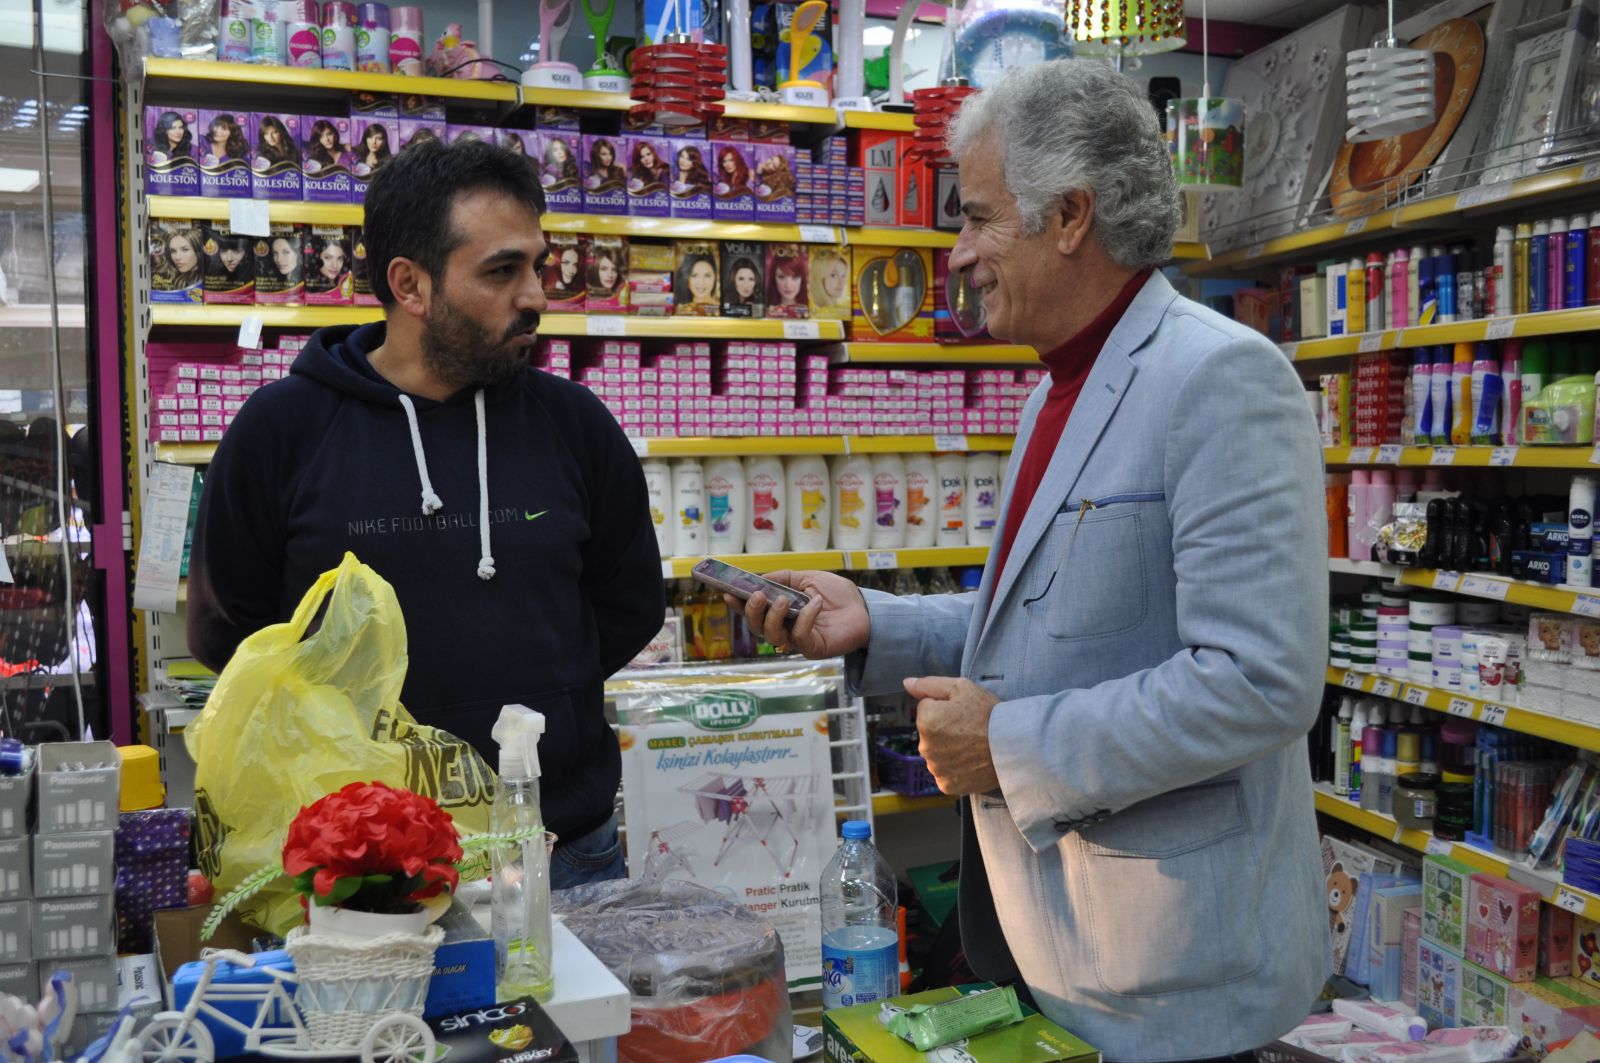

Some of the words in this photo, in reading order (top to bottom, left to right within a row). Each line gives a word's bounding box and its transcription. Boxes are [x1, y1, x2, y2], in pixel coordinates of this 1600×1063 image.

[871, 148, 892, 168] LM
[150, 174, 197, 185] KOLESTON
[202, 176, 249, 187] KOLESTON
[254, 178, 300, 189] KOLESTON
[305, 180, 350, 191] KOLESTON
[545, 192, 581, 204] OLESTON
[585, 194, 626, 206] KOLESTON
[628, 196, 669, 207] KOLESTON
[671, 197, 711, 210] KOLESTON
[715, 199, 754, 211] KOLESTON
[756, 201, 795, 213] KOLESTON
[942, 477, 961, 490] ipek
[974, 476, 994, 490] ipek
[348, 518, 387, 536] NIKE
[1547, 532, 1569, 541] ARKO
[1528, 560, 1550, 571] ARKO
[695, 700, 751, 719] DOLLY
[737, 728, 804, 741] KURUTMALIK
[656, 750, 700, 772] İşinizi
[50, 774, 107, 785] Panasonic
[43, 839, 101, 850] Panasonic
[745, 886, 777, 897] Pratic
[779, 882, 811, 894] Pratik
[42, 901, 99, 913] Panasonic
[443, 964, 467, 975] OLACAK
[440, 1002, 527, 1031] sinbo
